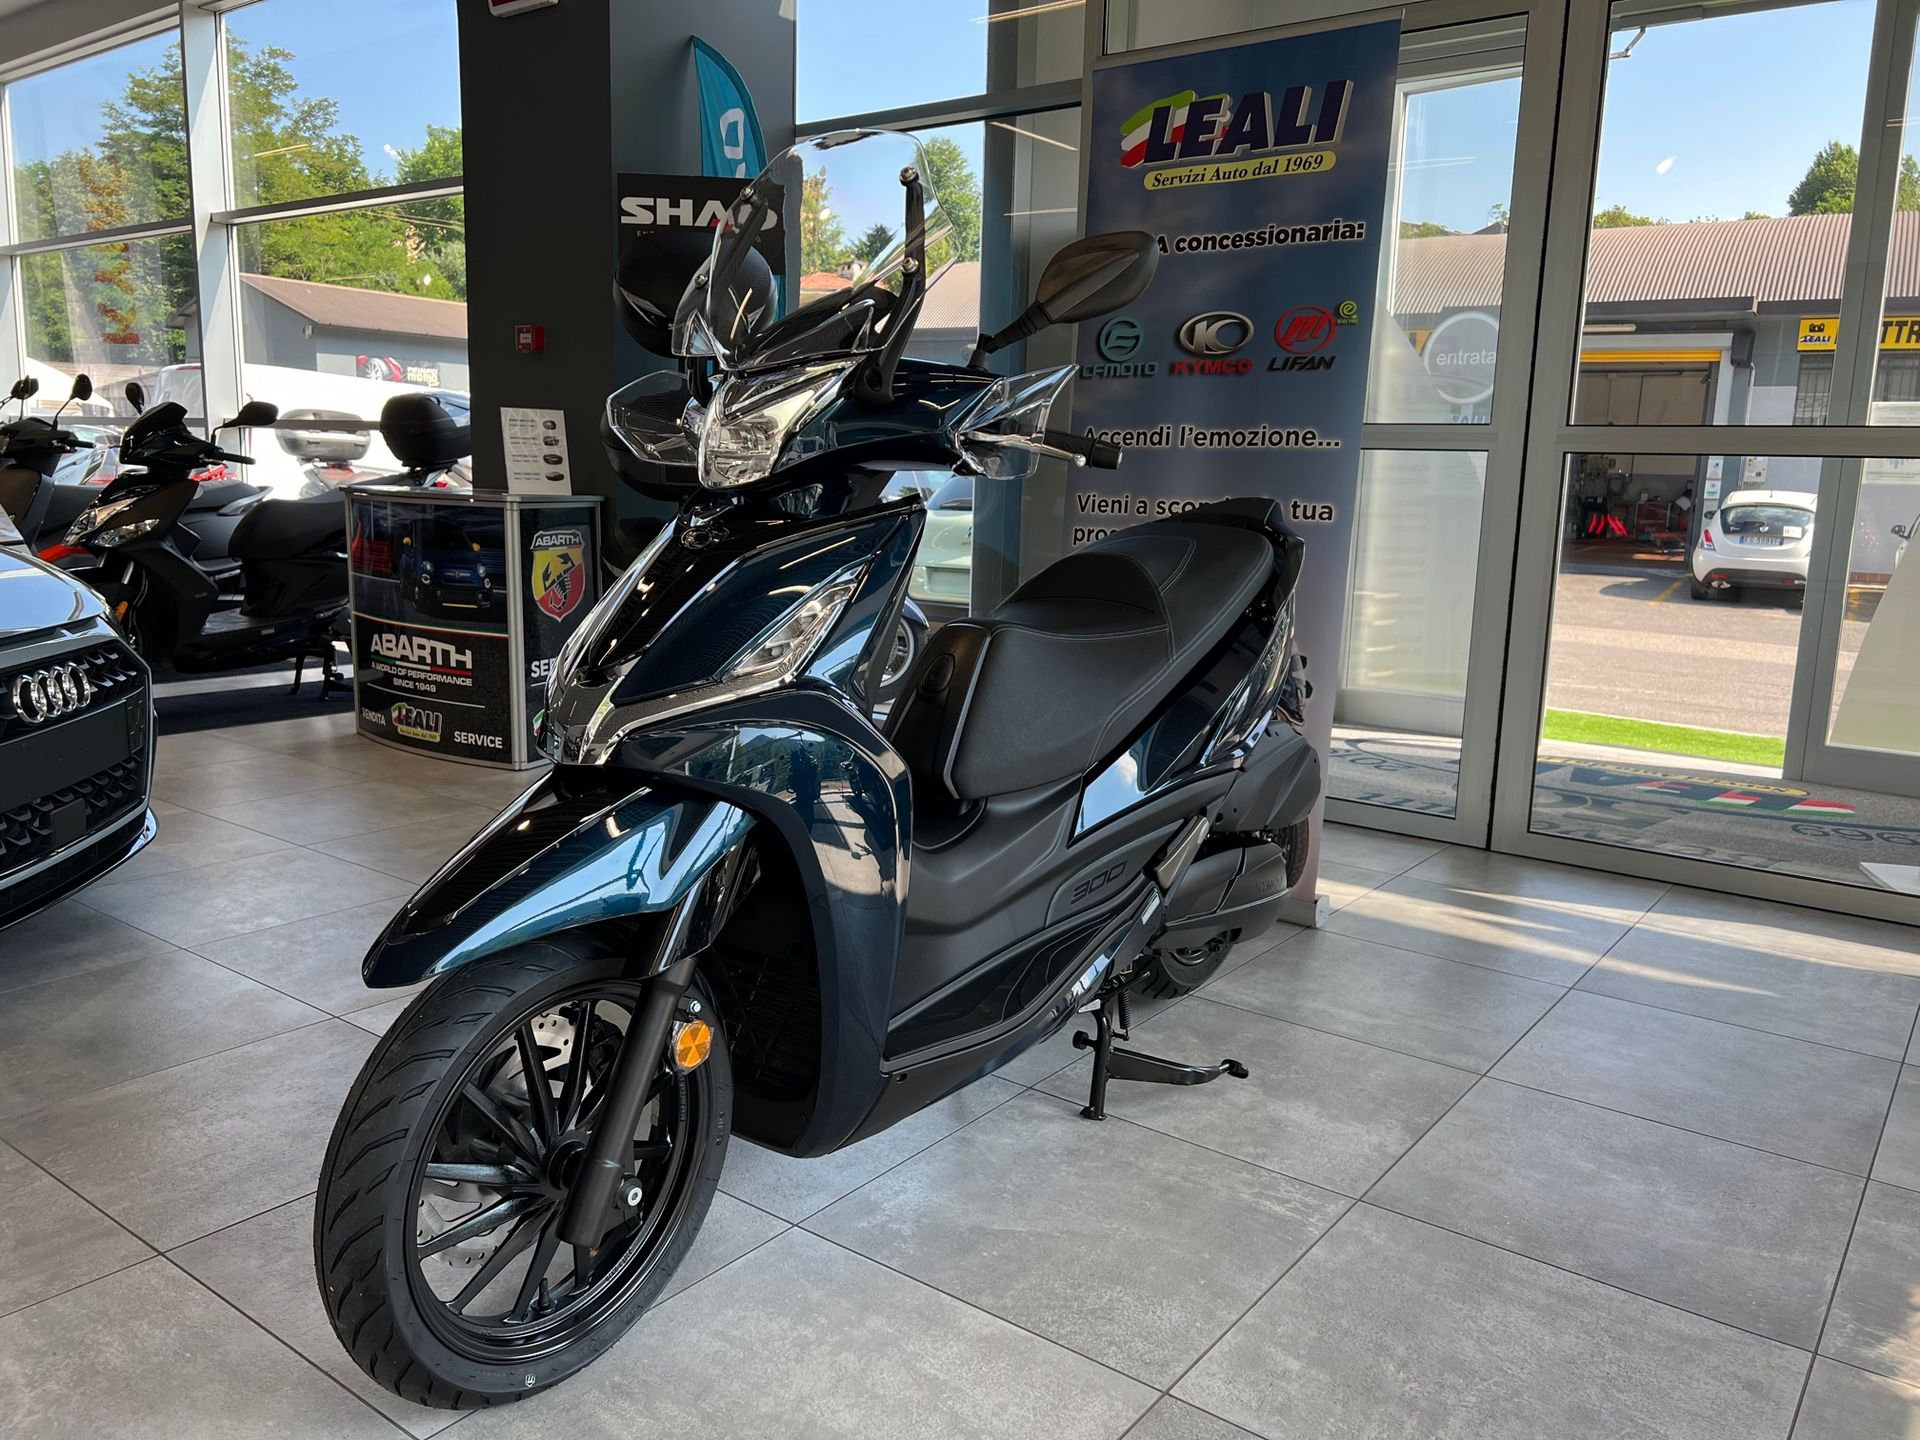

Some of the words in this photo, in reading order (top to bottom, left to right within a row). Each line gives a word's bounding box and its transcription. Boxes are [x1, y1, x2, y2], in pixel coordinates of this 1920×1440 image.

[1143, 79, 1354, 164] LEALI
[1151, 170, 1205, 188] Servizi
[1209, 166, 1248, 182] Auto
[1252, 159, 1279, 177] dal
[1283, 154, 1324, 173] 1969
[1174, 218, 1366, 253] concessionaria:
[1173, 358, 1255, 376] KYMCO
[1267, 355, 1337, 372] LIFAN
[1436, 348, 1496, 366] entrata
[1081, 361, 1158, 378] CFMOTO
[1084, 425, 1172, 448] Accendi
[1077, 494, 1130, 515] Vieni
[1136, 498, 1149, 515] a
[1291, 499, 1334, 522] tua
[535, 535, 581, 547] ABARTH
[370, 633, 473, 670] ABARTH
[375, 662, 397, 674] WORLD
[397, 667, 407, 676] OF
[407, 669, 473, 687] PERFORMANCE
[393, 677, 415, 689] SINCE
[415, 682, 436, 693] 1949
[362, 706, 386, 727] VENDITA
[397, 704, 443, 735] LEALI
[454, 730, 504, 749] SERVICE
[1071, 859, 1129, 905] 300
